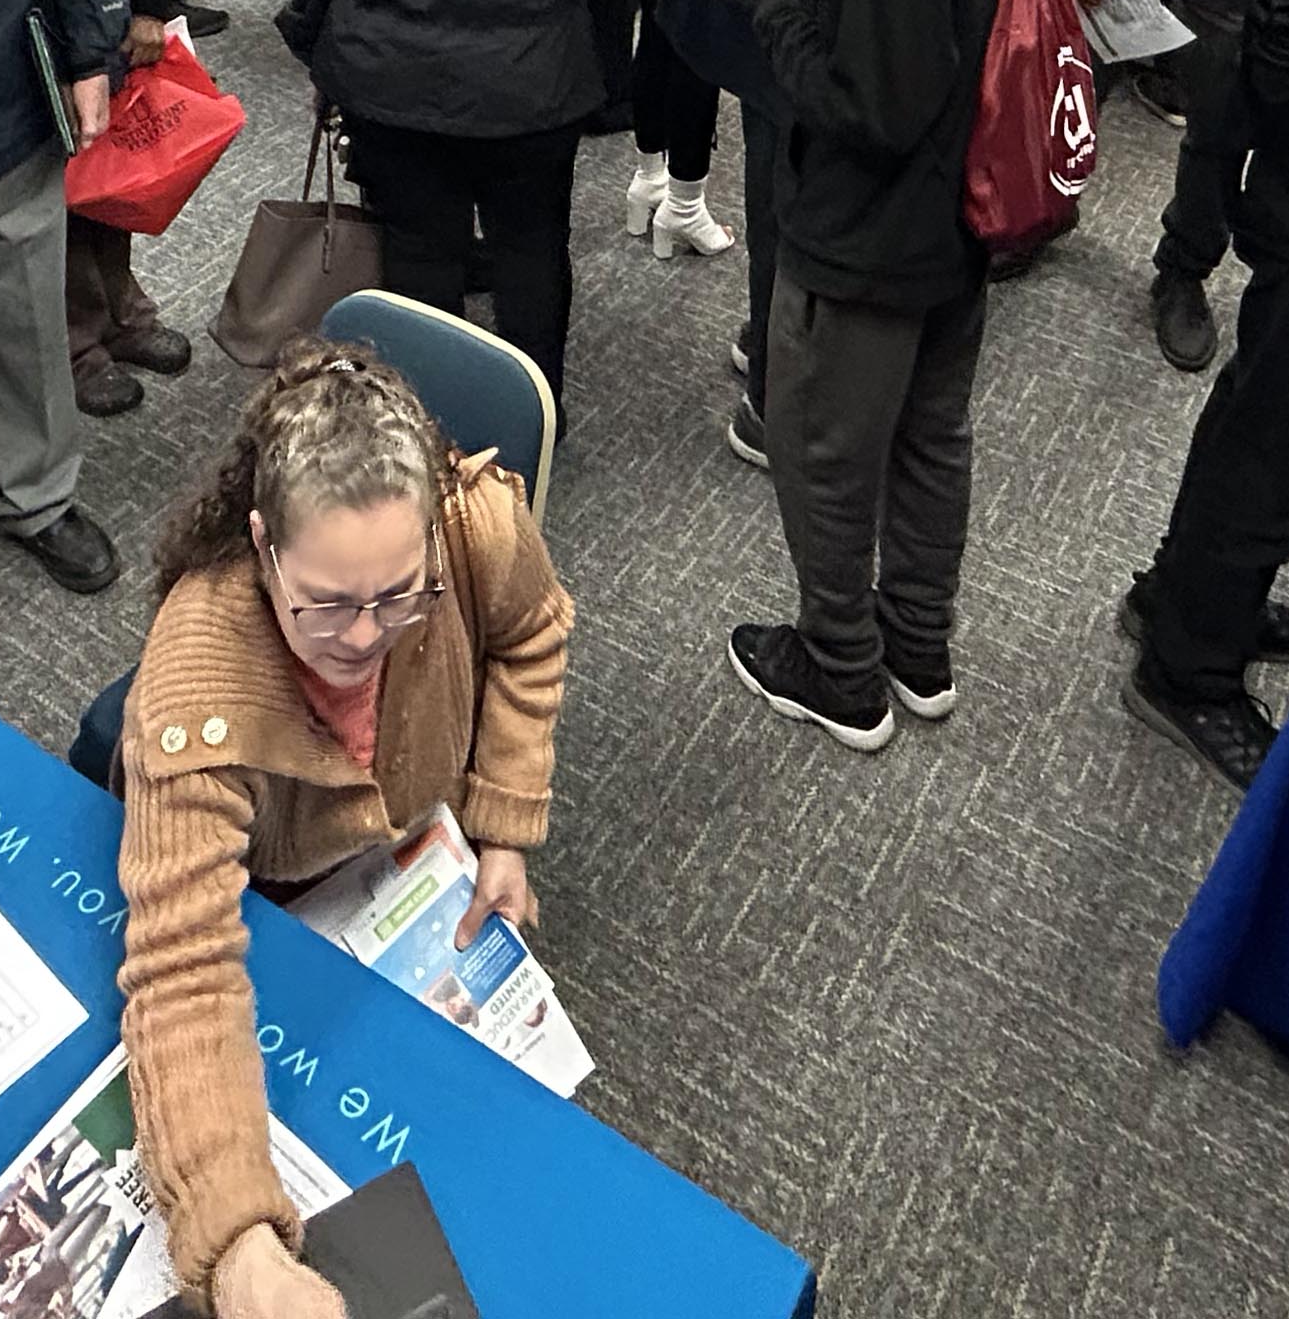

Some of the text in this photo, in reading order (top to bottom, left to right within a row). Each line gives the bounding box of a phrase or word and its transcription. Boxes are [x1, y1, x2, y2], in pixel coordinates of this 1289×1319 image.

[50, 856, 128, 936] you.
[486, 977, 542, 1043] PARAEDUC
[490, 968, 533, 1016] WANTED
[255, 1023, 320, 1087] wo
[339, 1086, 411, 1167] We
[114, 1173, 155, 1217] FREE
